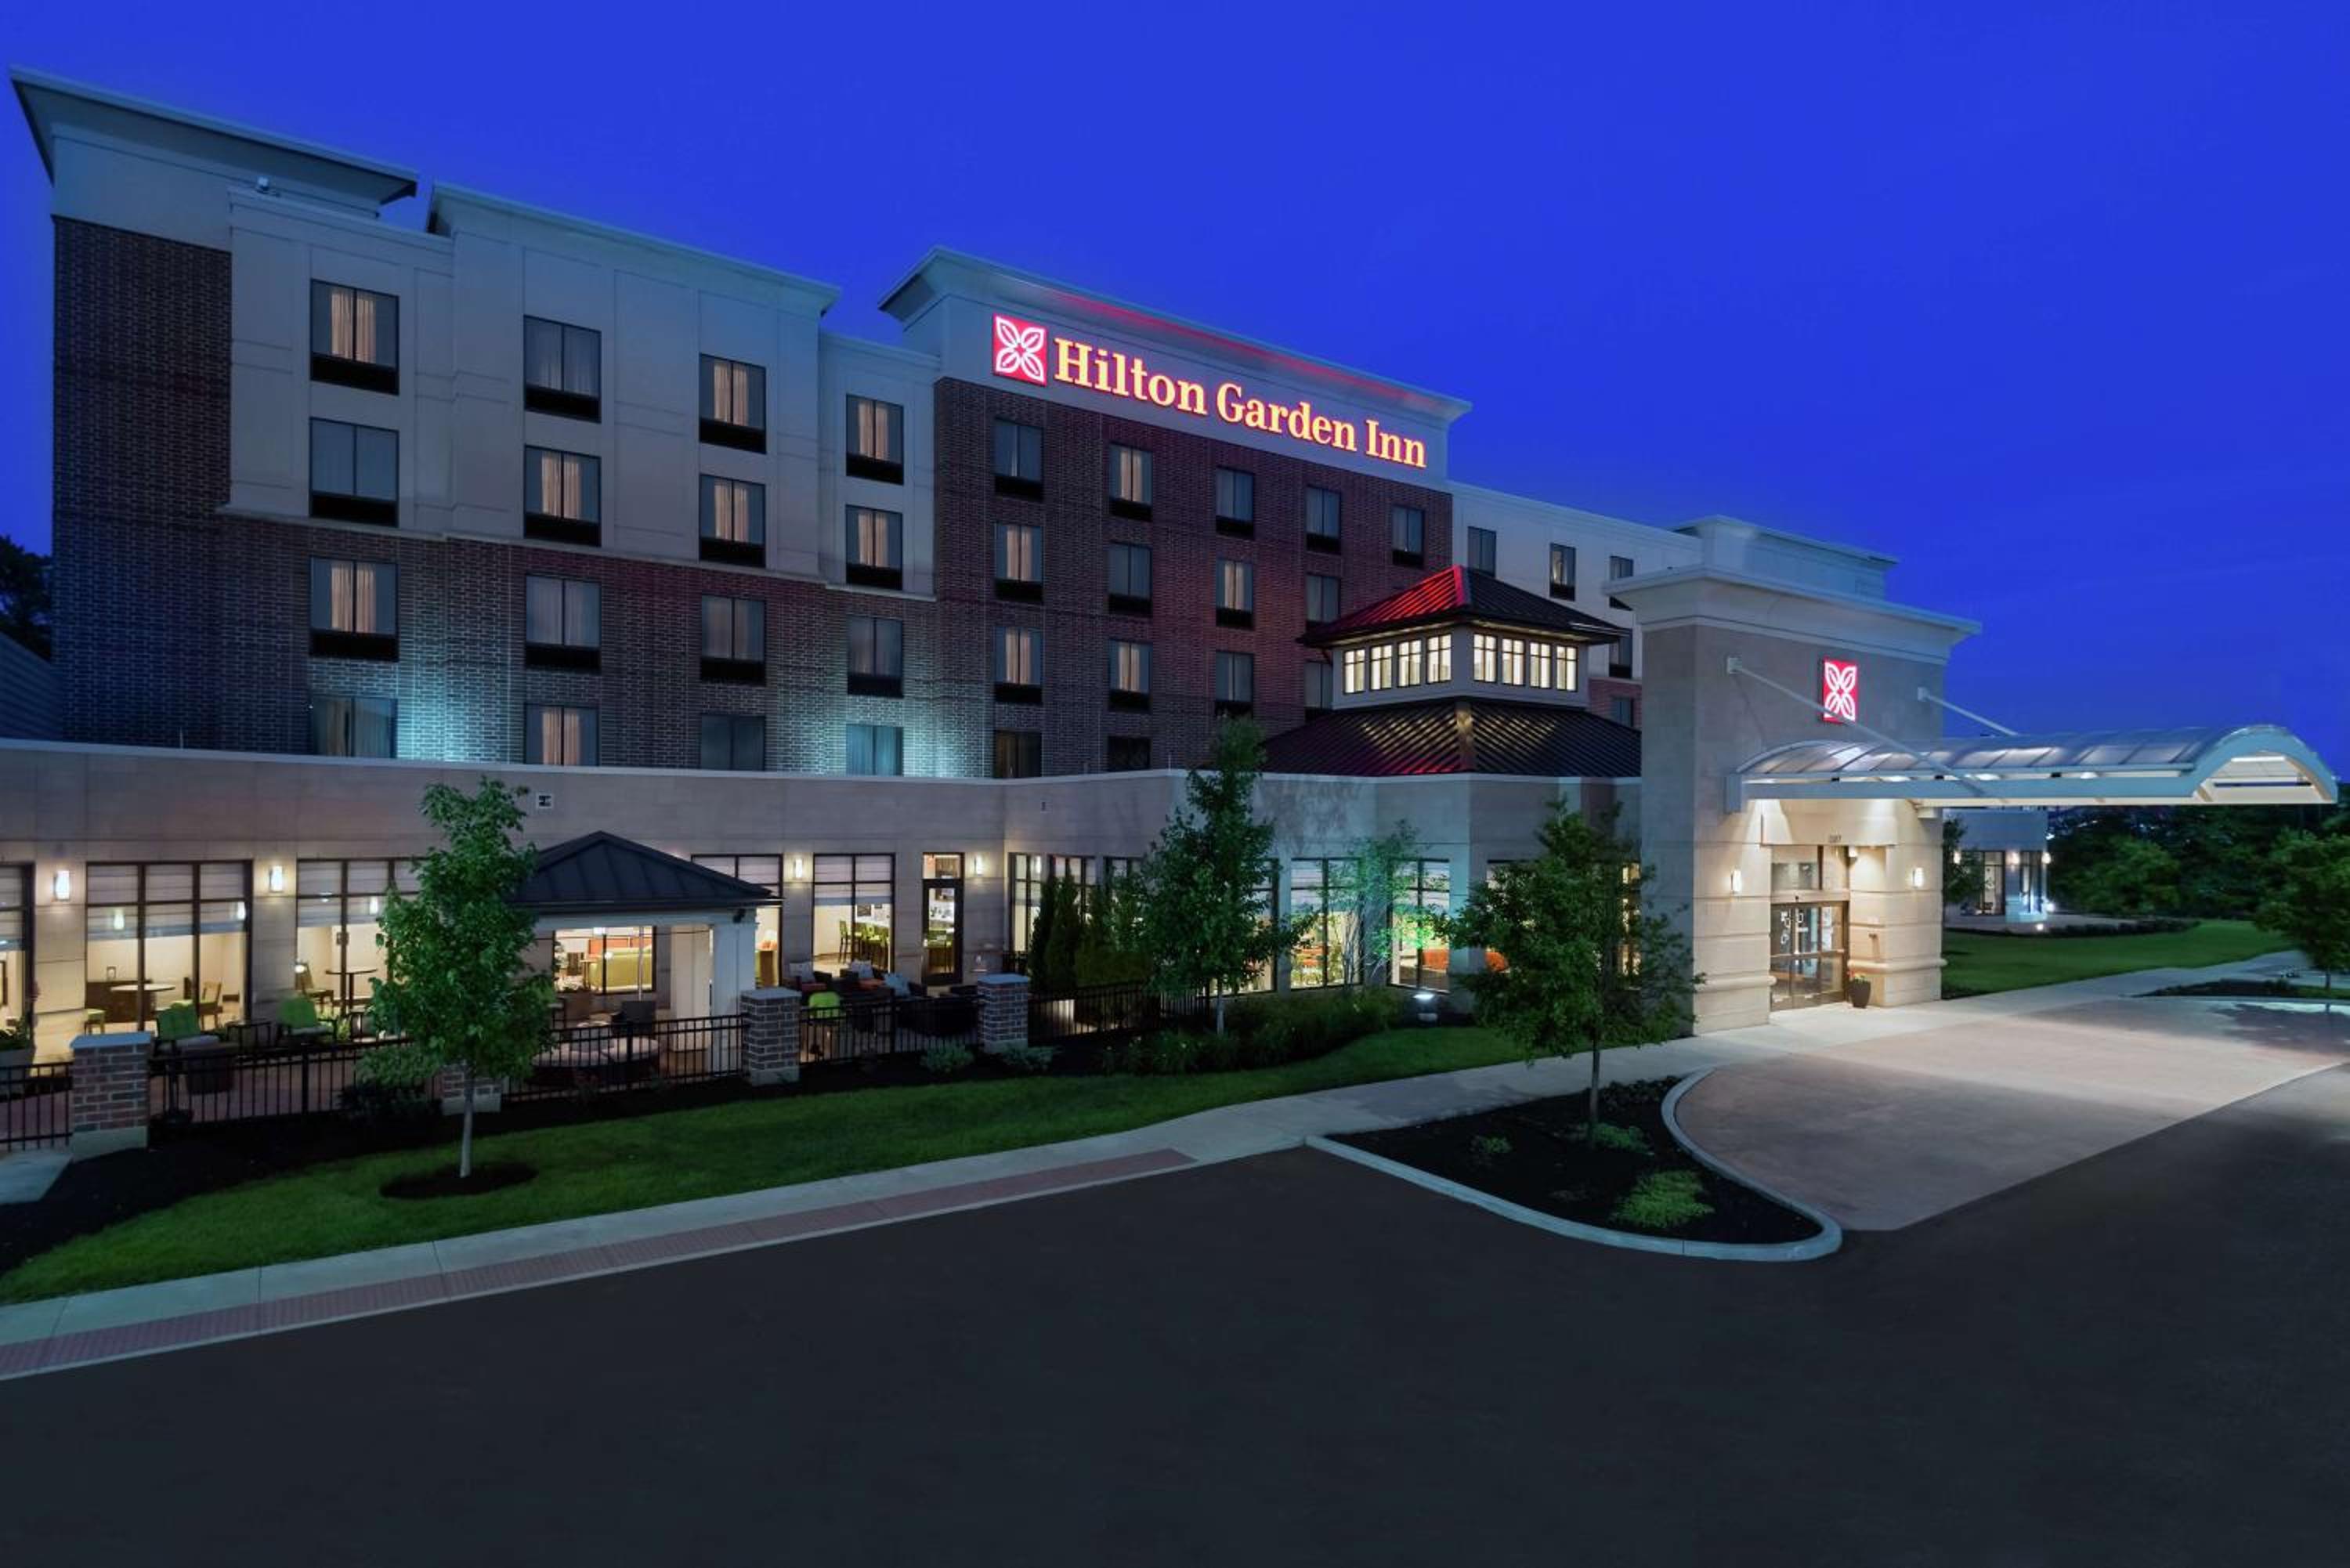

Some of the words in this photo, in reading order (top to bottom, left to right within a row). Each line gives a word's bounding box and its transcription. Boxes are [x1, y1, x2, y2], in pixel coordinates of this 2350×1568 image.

[1054, 338, 1208, 415] Hilton
[1217, 382, 1358, 452] Garden
[1365, 419, 1426, 468] Inn
